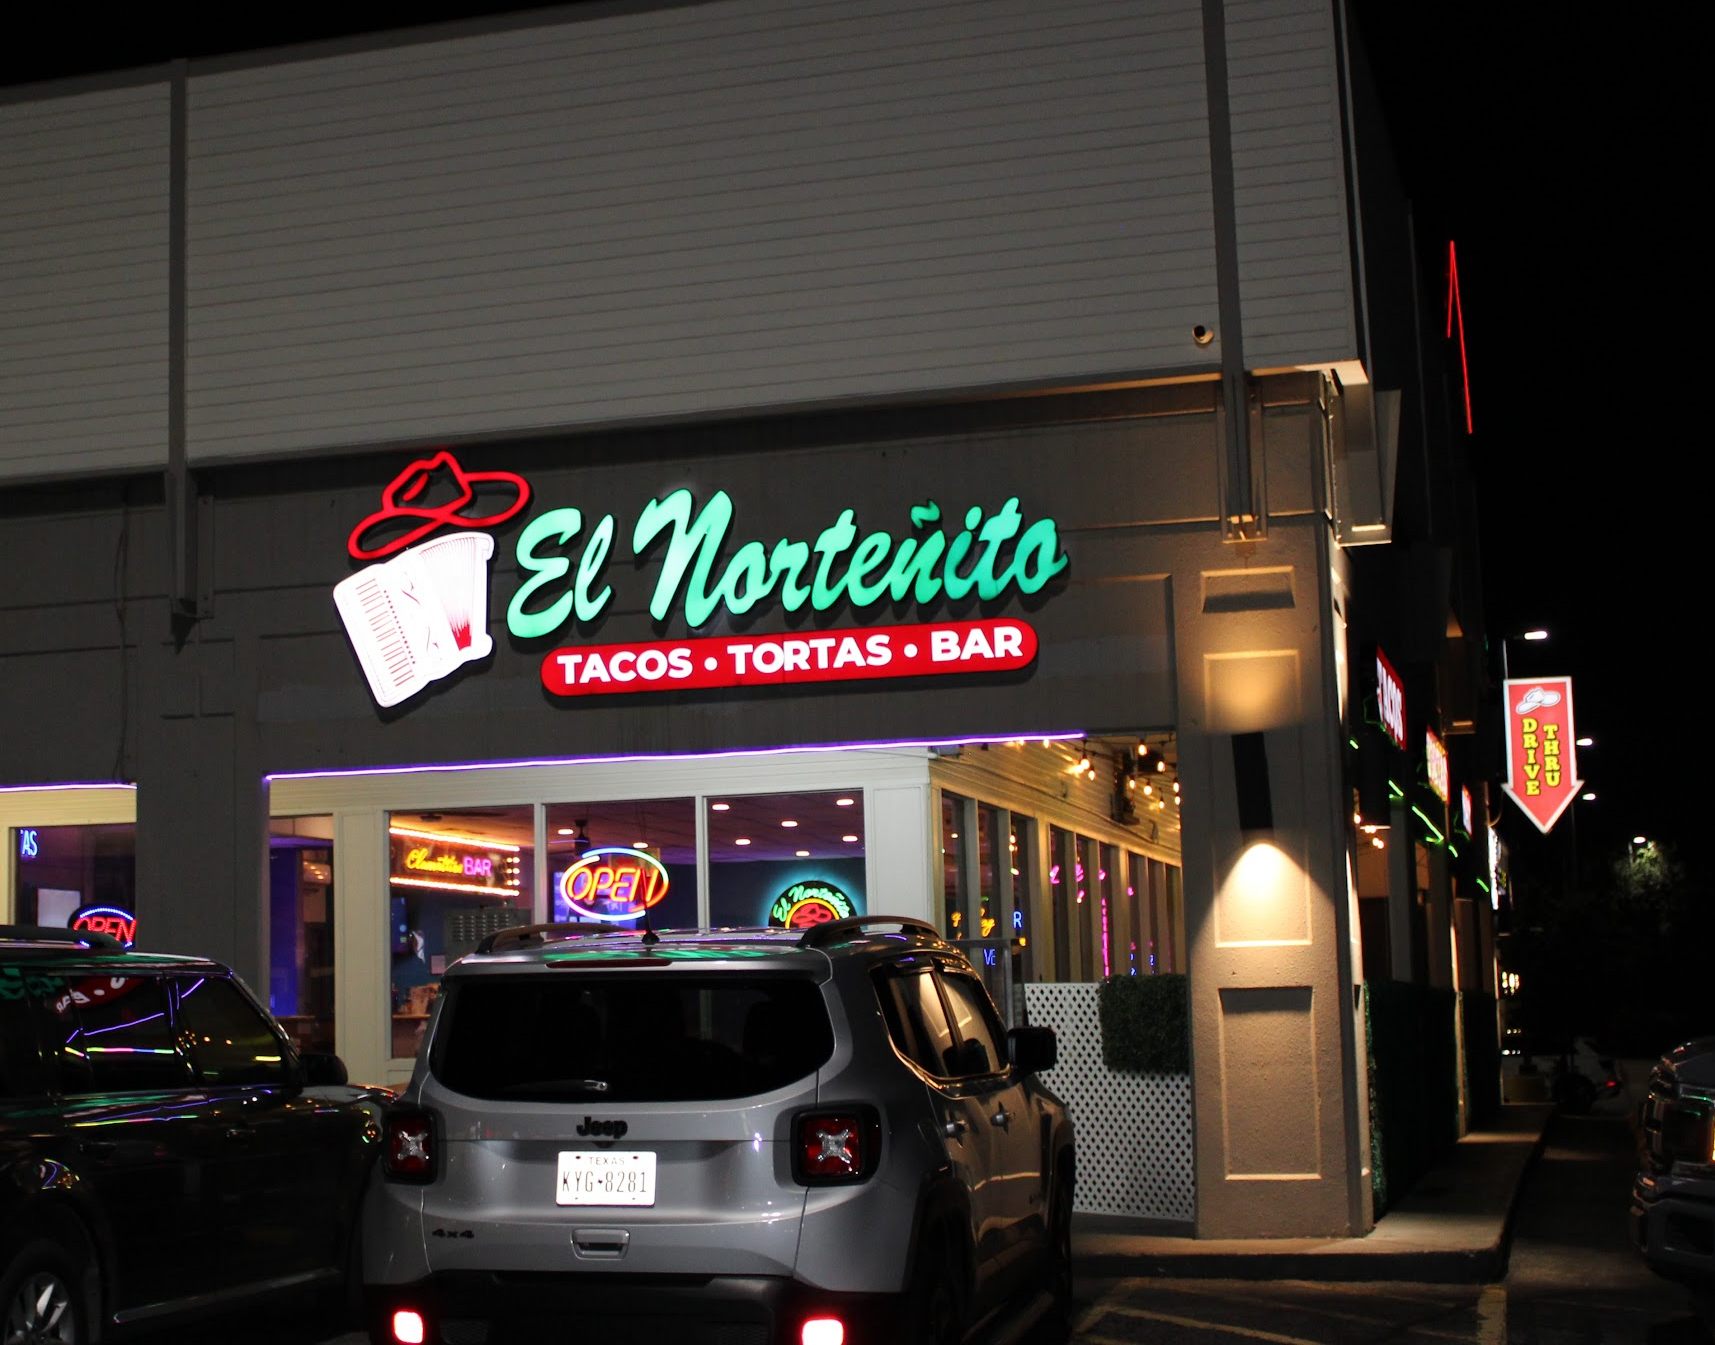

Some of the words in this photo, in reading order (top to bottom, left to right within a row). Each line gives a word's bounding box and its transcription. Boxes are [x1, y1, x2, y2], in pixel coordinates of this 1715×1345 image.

[506, 506, 614, 639] El
[632, 488, 1069, 628] Norteñito
[557, 647, 693, 685] TACOS
[727, 634, 893, 675] TORTAS
[930, 626, 1023, 662] BAR
[1522, 717, 1541, 796] DRIVE
[1543, 724, 1561, 787] THRU
[20, 829, 38, 857] AS
[463, 856, 492, 876] BAR
[566, 866, 660, 902] OPEN
[576, 1116, 628, 1139] Jeep
[589, 1156, 625, 1166] TEXAS
